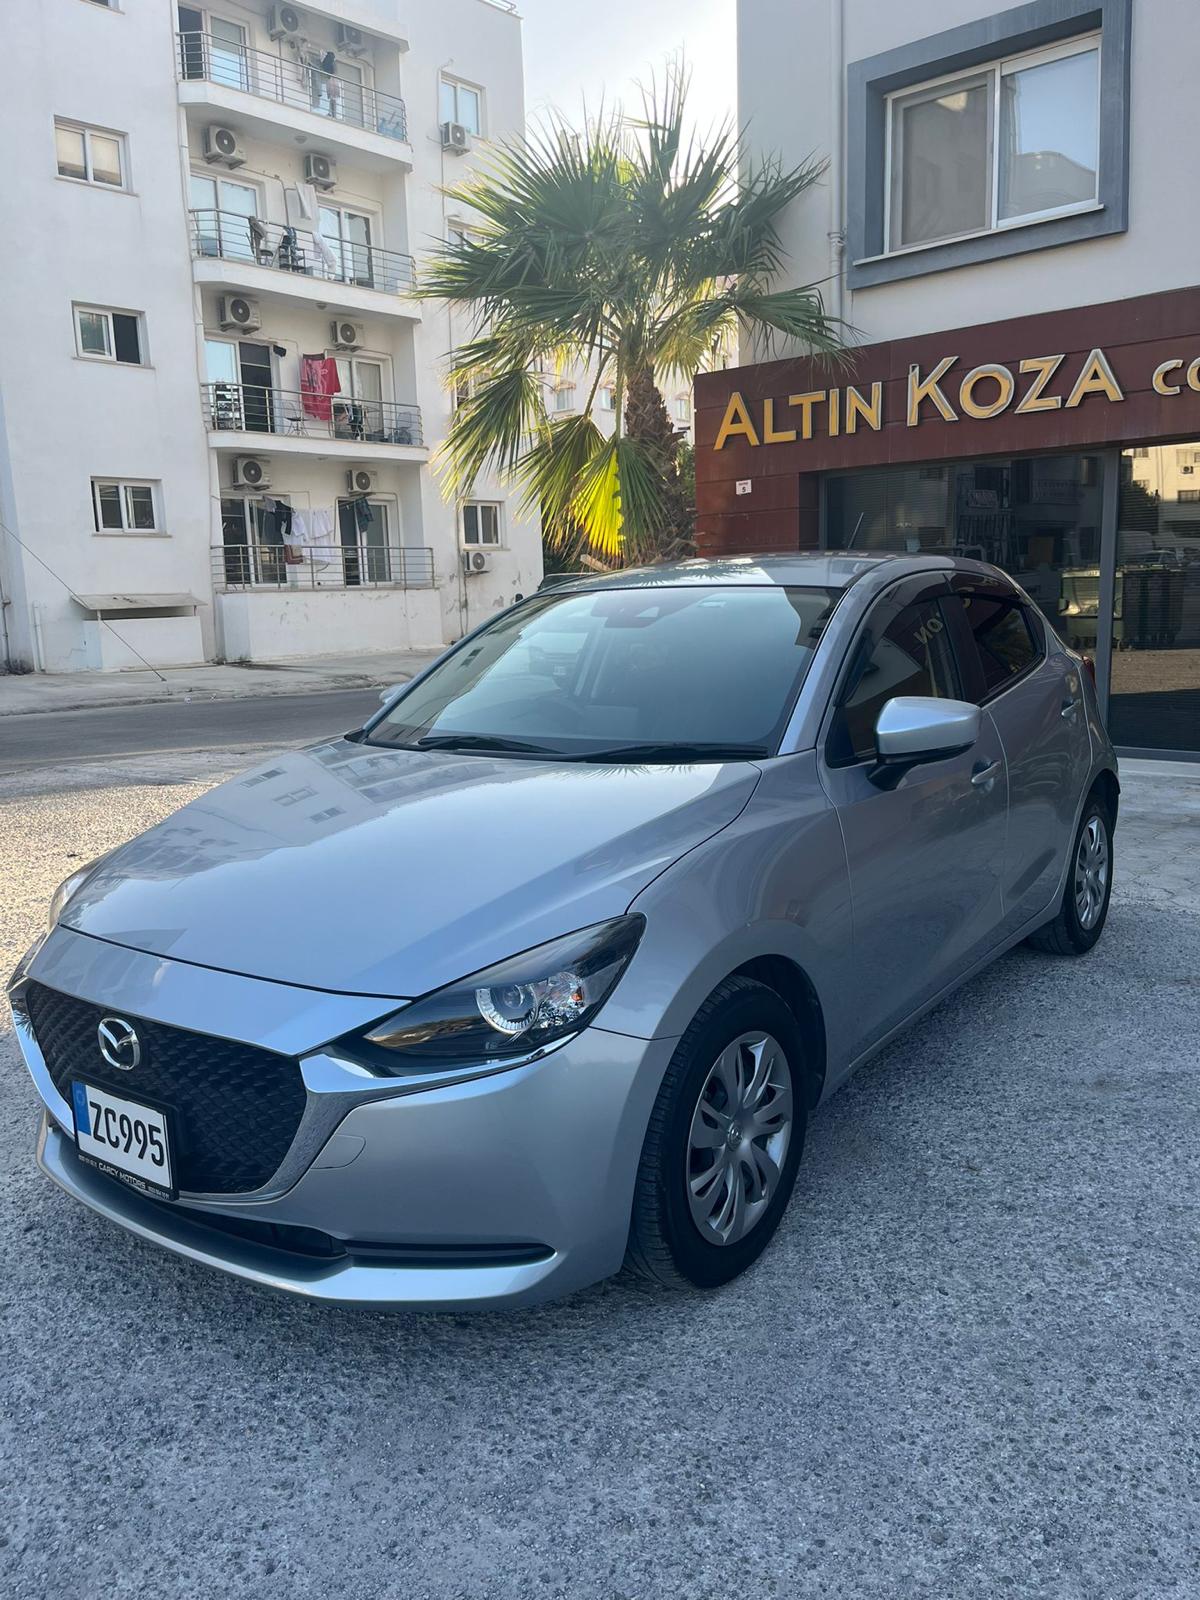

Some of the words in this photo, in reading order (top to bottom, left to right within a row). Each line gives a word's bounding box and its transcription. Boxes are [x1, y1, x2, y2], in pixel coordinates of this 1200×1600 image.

[713, 381, 883, 450] ALTIN
[907, 348, 1124, 427] KOZA
[89, 1100, 165, 1168] ZC995
[119, 1171, 146, 1190] MOTORS
